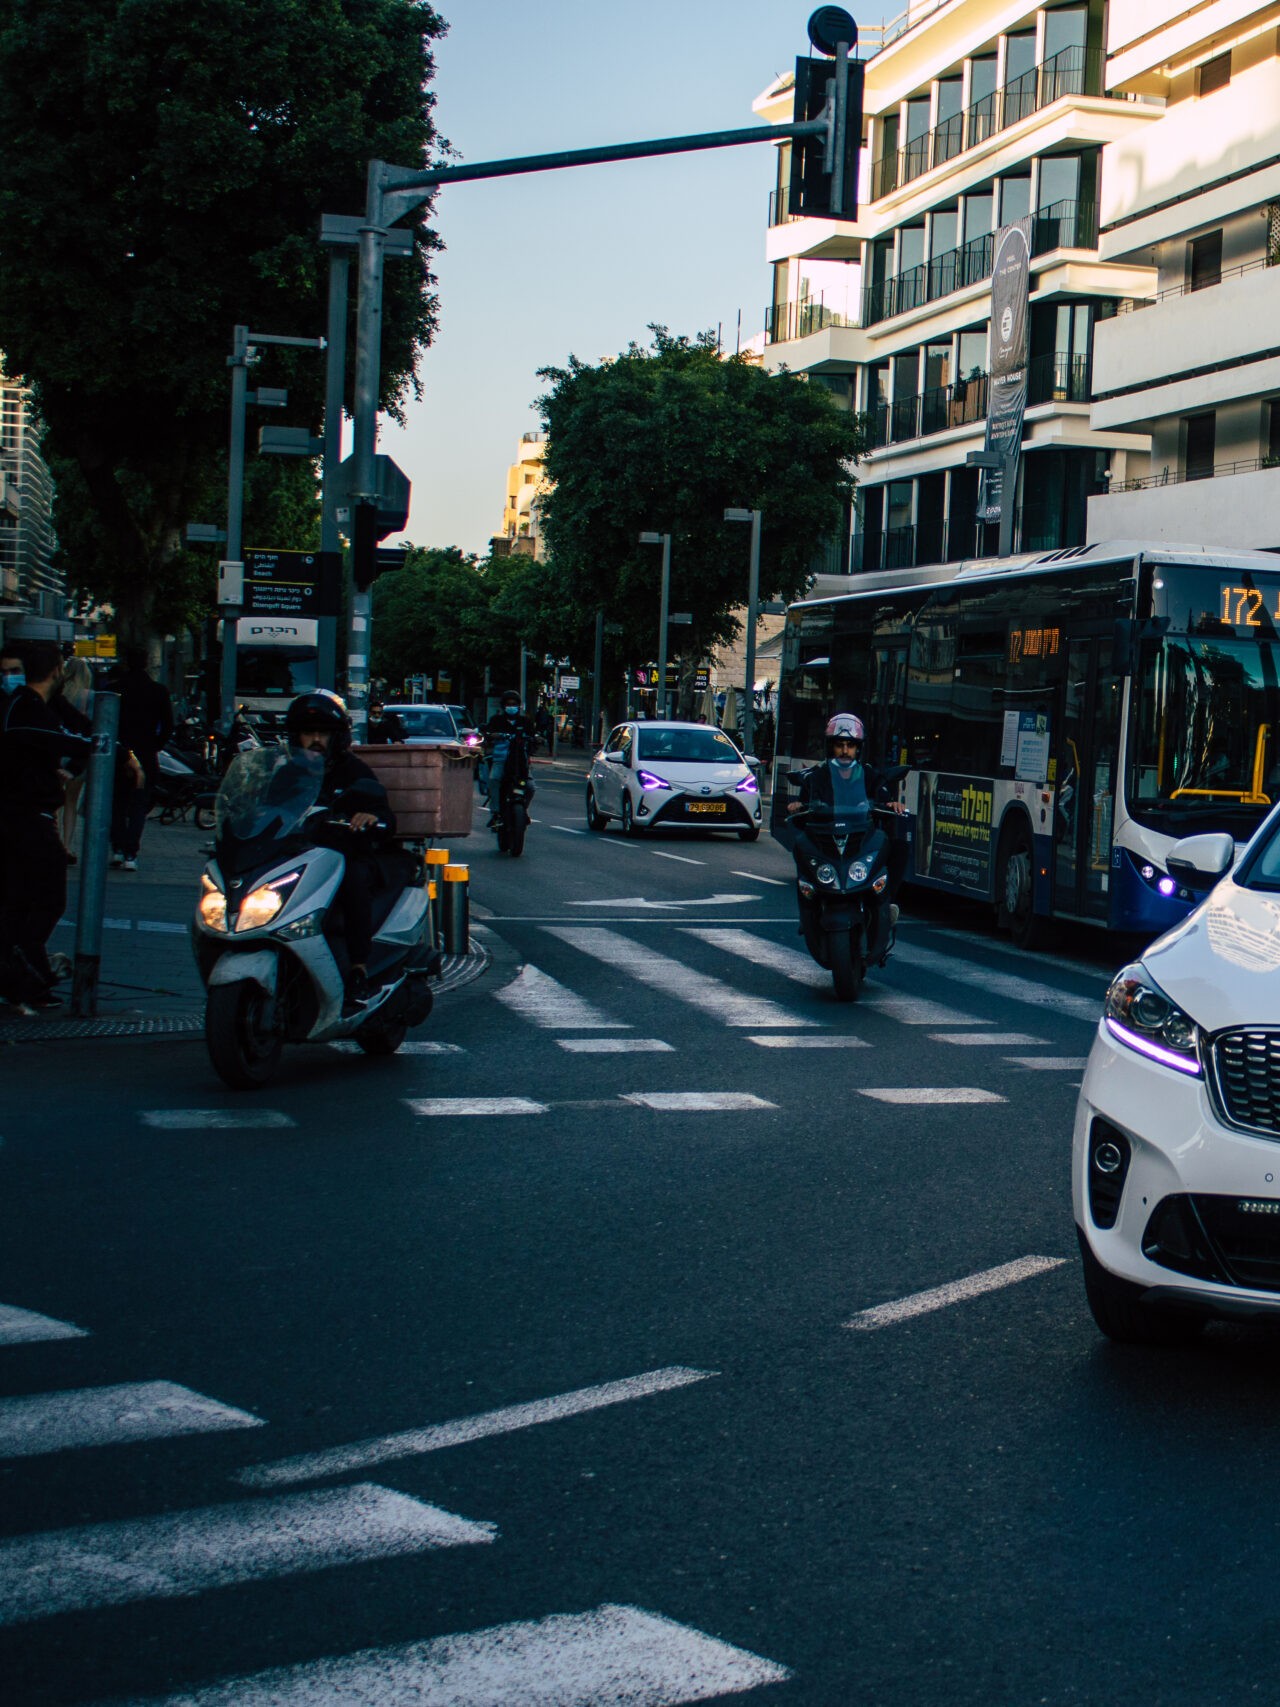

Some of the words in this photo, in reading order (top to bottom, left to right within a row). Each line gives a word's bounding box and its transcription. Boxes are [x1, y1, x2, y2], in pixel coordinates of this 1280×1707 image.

[252, 602, 280, 610] Dizengoff
[280, 603, 302, 611] Square
[1221, 587, 1263, 626] 172
[250, 626, 298, 636] הכרם
[1008, 631, 1022, 664] 172
[961, 783, 992, 824] הפלה
